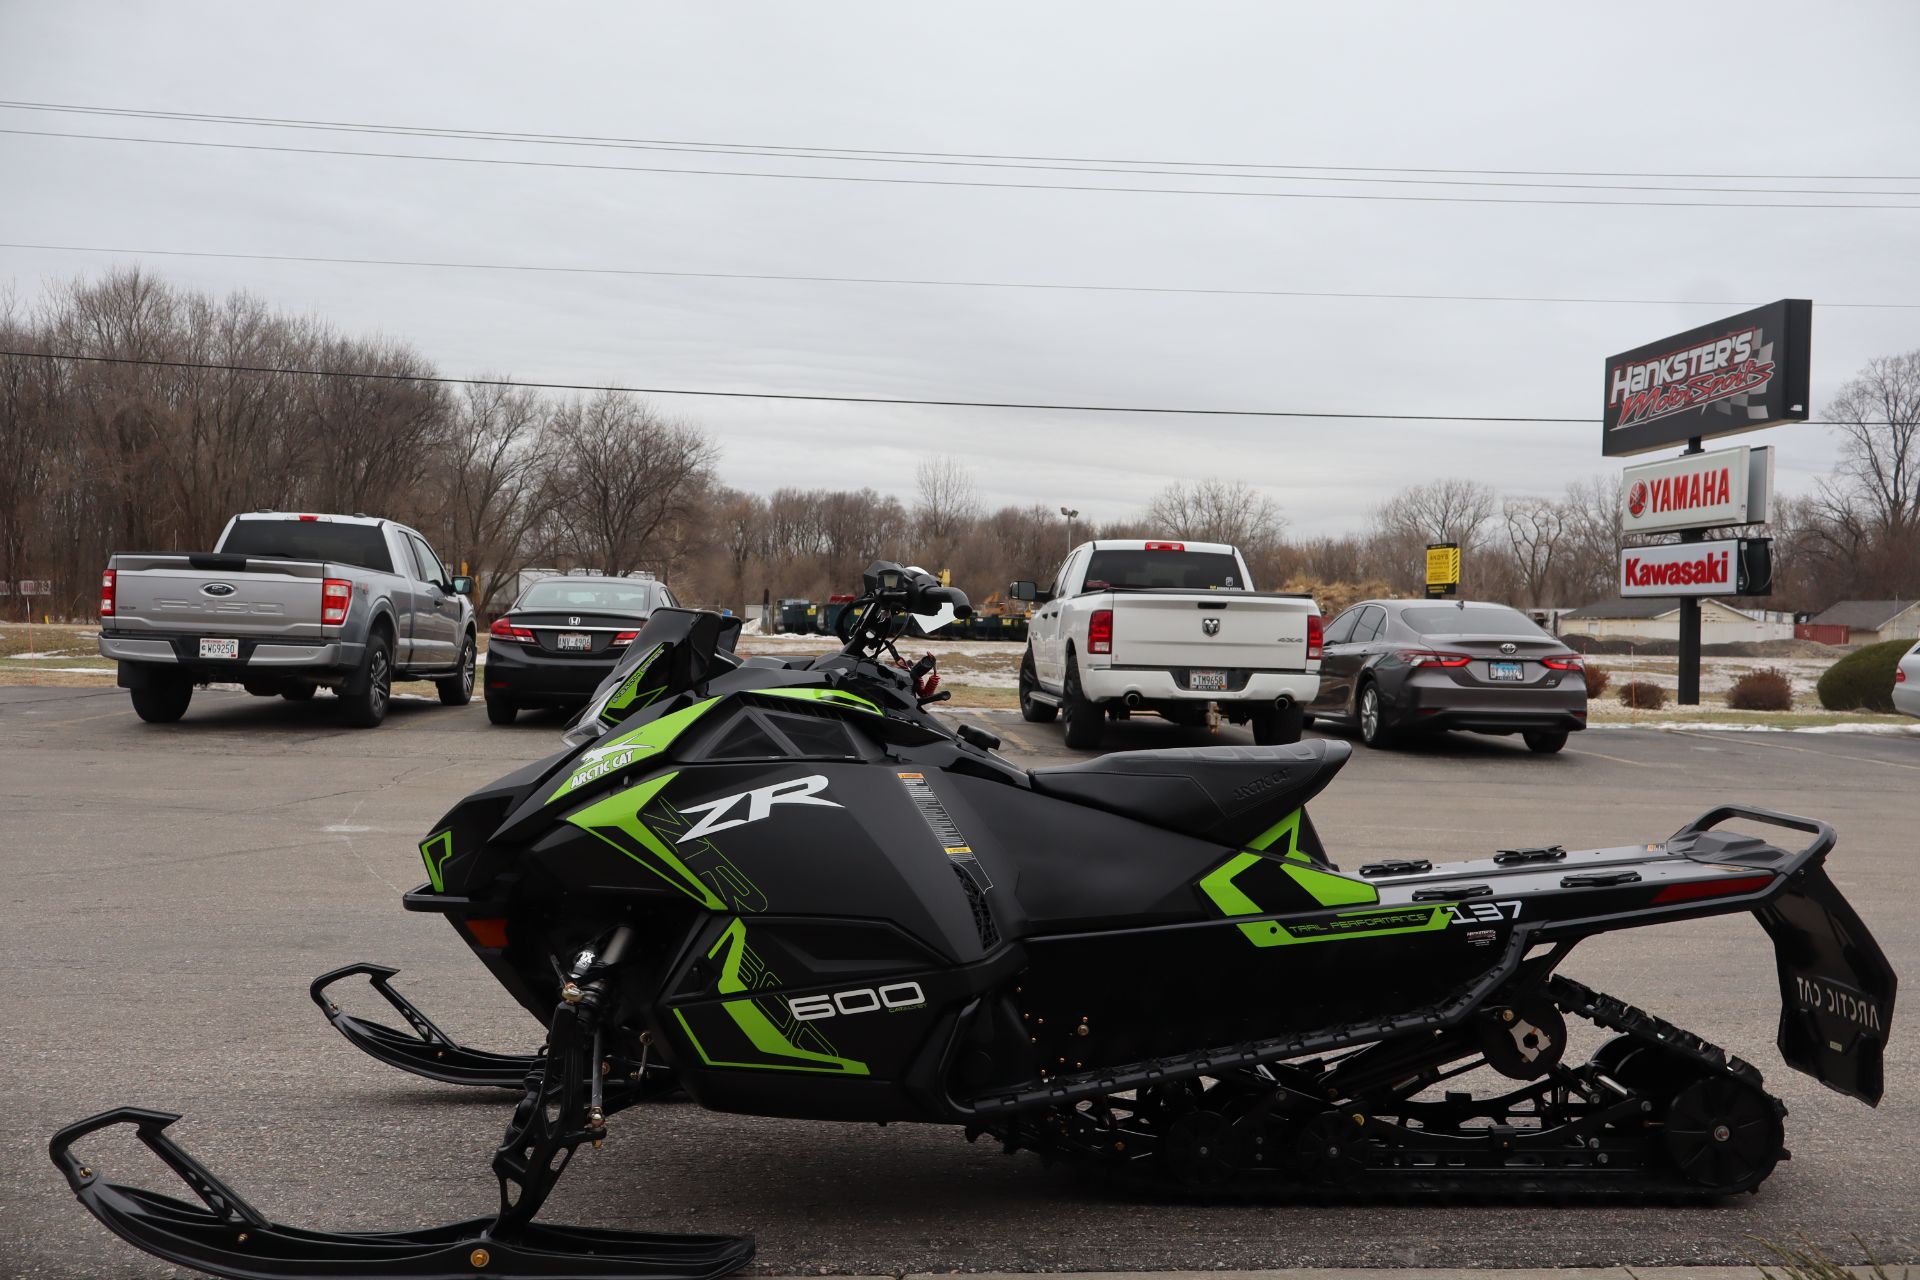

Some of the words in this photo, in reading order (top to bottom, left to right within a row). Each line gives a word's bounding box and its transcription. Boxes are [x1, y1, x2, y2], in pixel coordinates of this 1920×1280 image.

[1650, 467, 1730, 513] YAMAHA
[1625, 551, 1729, 587] Kawasaki
[570, 761, 611, 790] ARCTIC
[612, 749, 635, 769] CAT
[674, 774, 847, 845] ZR
[1289, 924, 1329, 934] TRAIL
[1330, 912, 1429, 930] PERFORMANCE
[1446, 900, 1523, 925] 137
[788, 981, 926, 1021] 600
